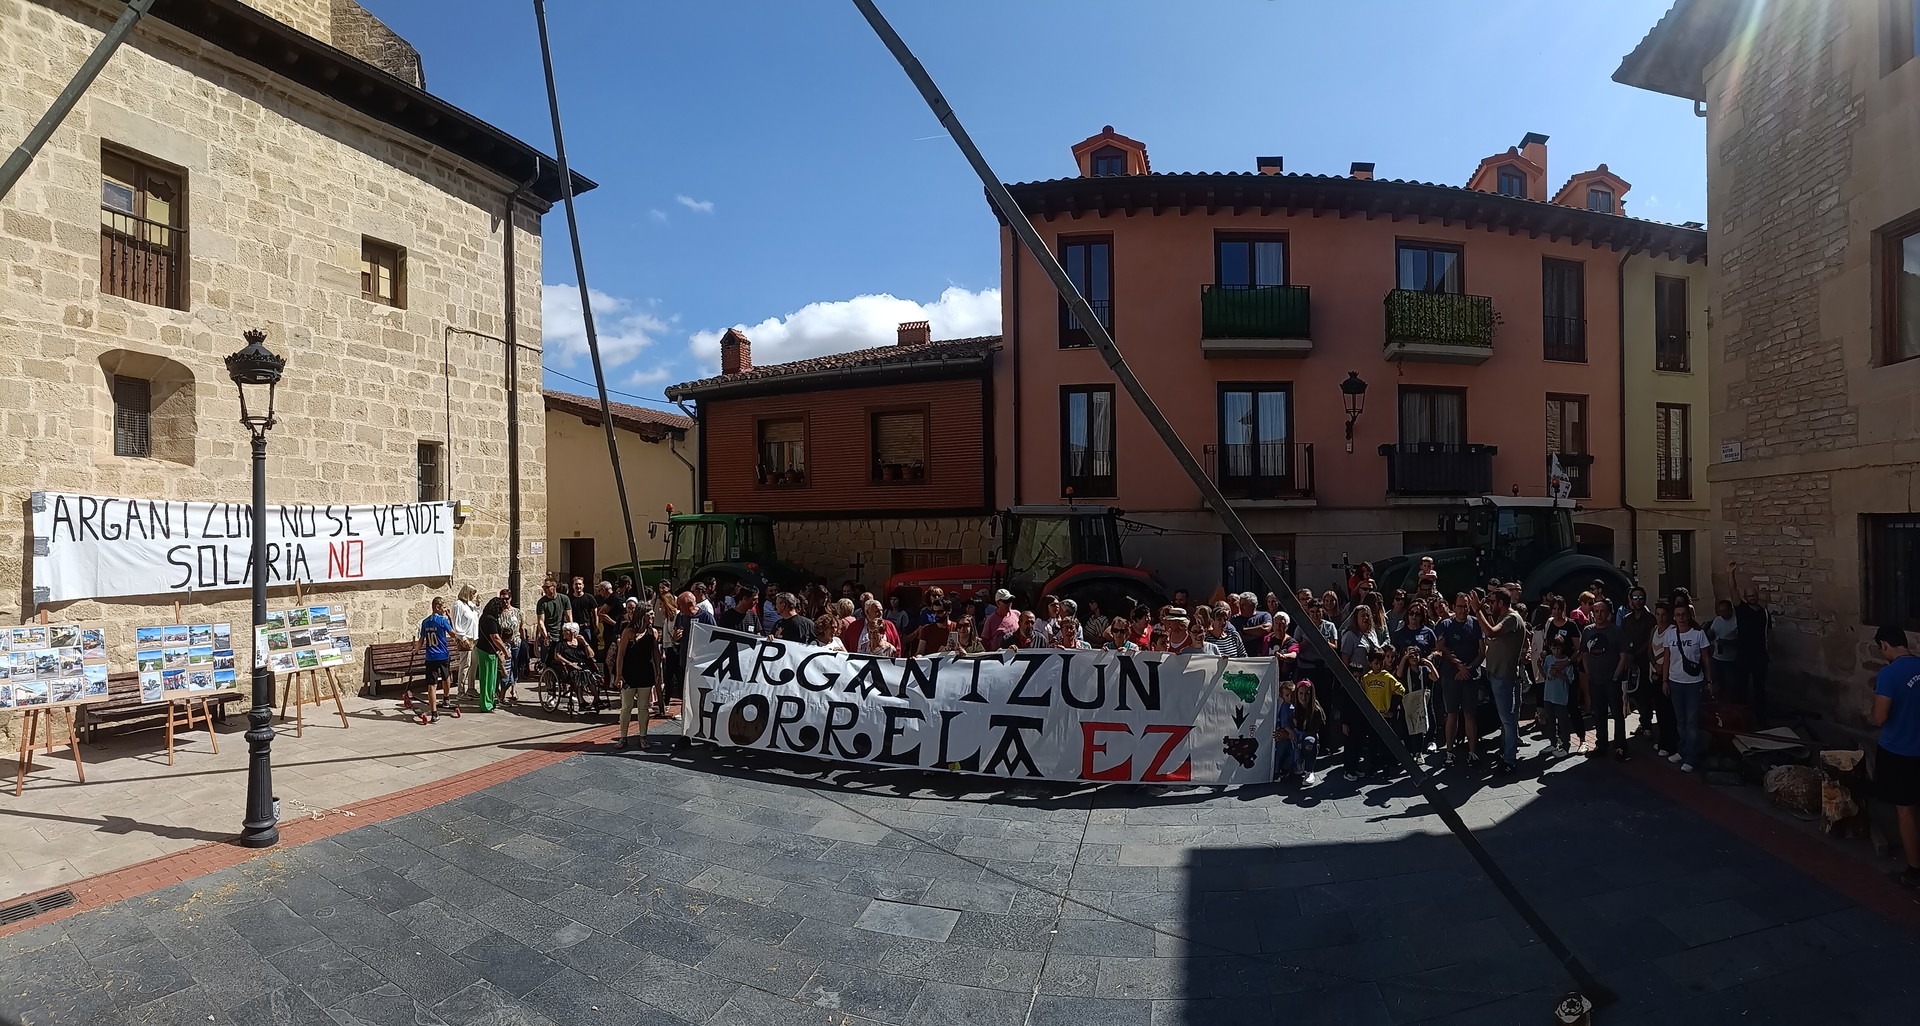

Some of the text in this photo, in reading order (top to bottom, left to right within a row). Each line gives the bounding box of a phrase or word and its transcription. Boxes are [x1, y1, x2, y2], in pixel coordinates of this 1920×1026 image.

[373, 503, 445, 537] VENDE
[328, 540, 363, 579] NO
[427, 632, 439, 647] 10
[701, 630, 1162, 711] ARGANTZUN
[696, 687, 1196, 782] HORRELA EZ
